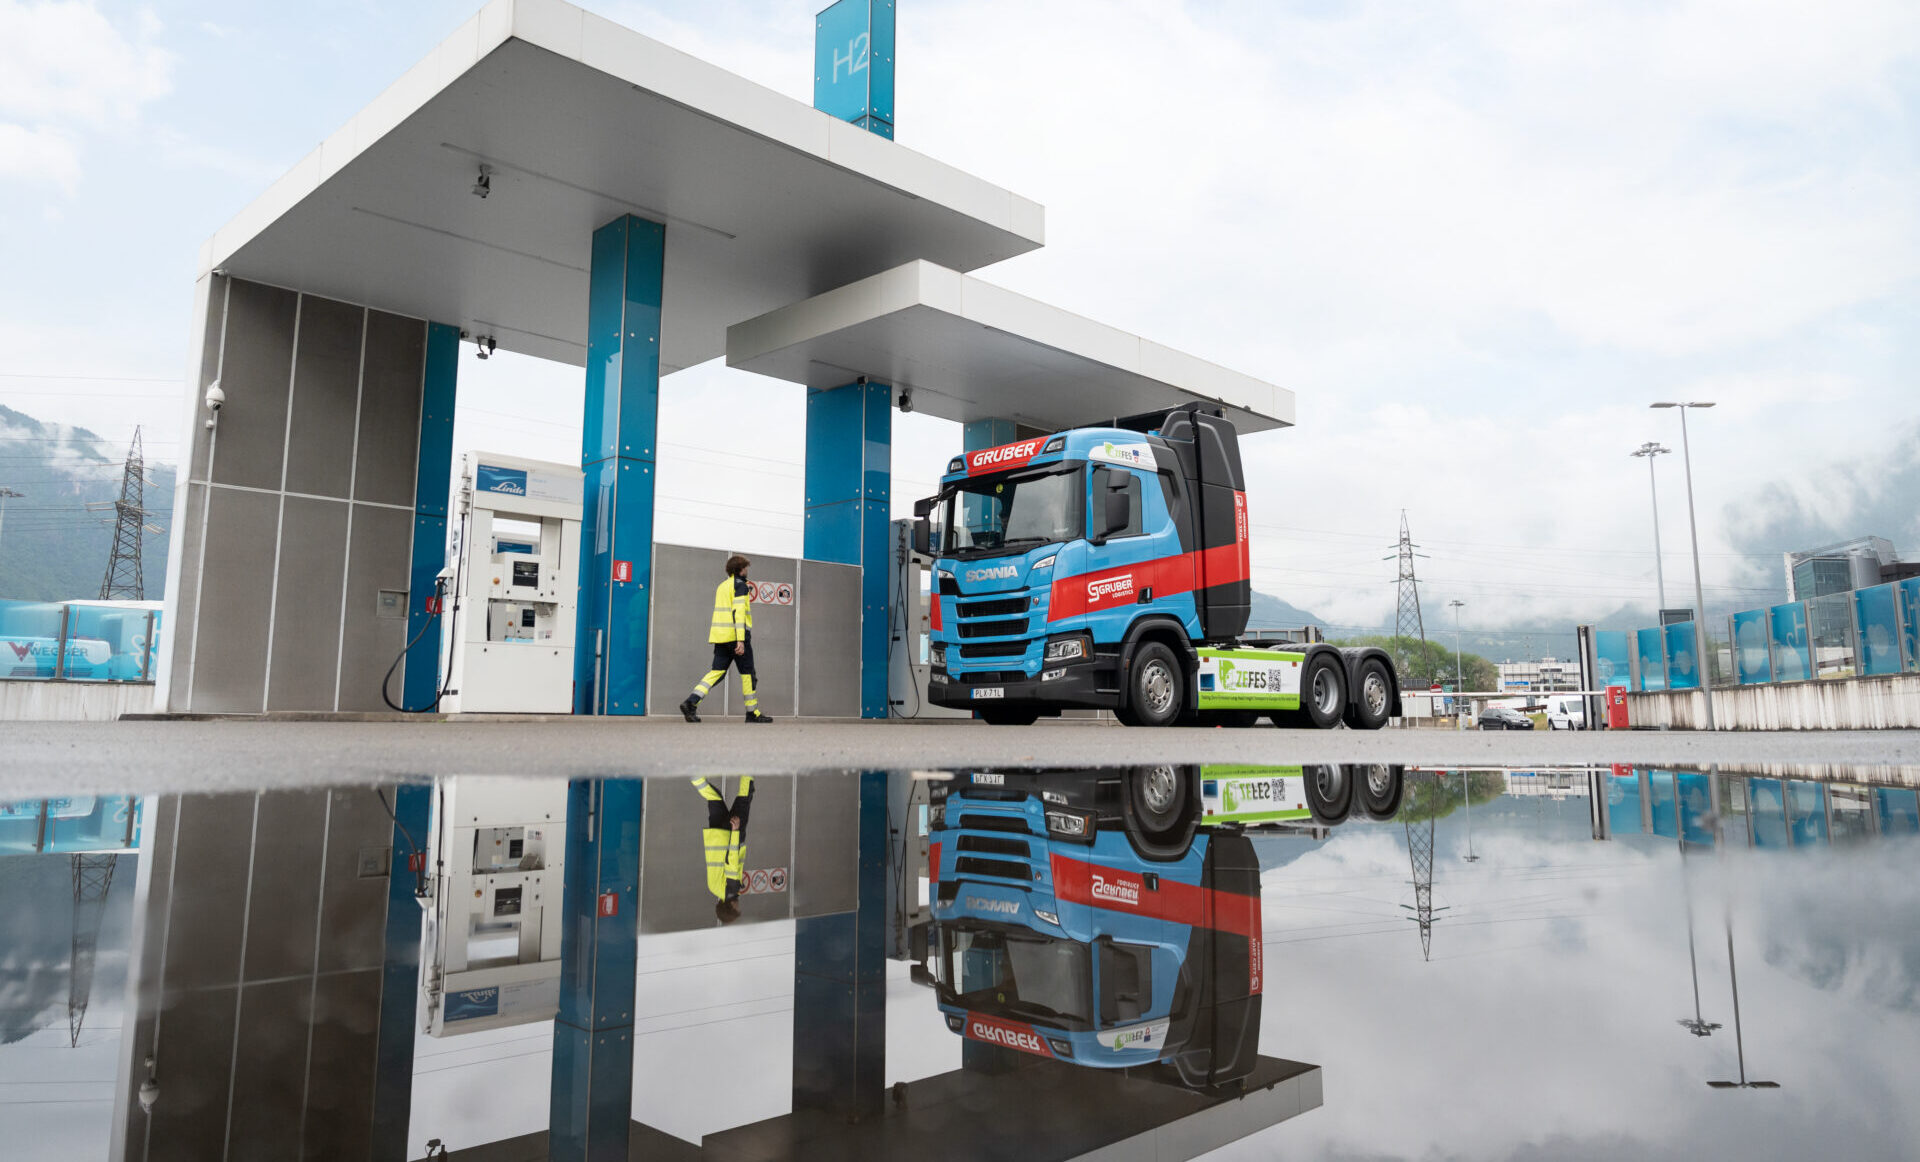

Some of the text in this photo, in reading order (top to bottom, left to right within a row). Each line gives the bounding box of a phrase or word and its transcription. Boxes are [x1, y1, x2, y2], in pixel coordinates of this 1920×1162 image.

[832, 32, 869, 84] H2
[973, 443, 1036, 467] GRUBER
[490, 481, 524, 495] Linde
[965, 565, 1018, 583] SCANIA
[1099, 579, 1133, 594] GRUBER
[1112, 589, 1134, 598] LOGISTICS
[1236, 671, 1266, 689] ZEFES
[975, 688, 1001, 698] PLX 71L
